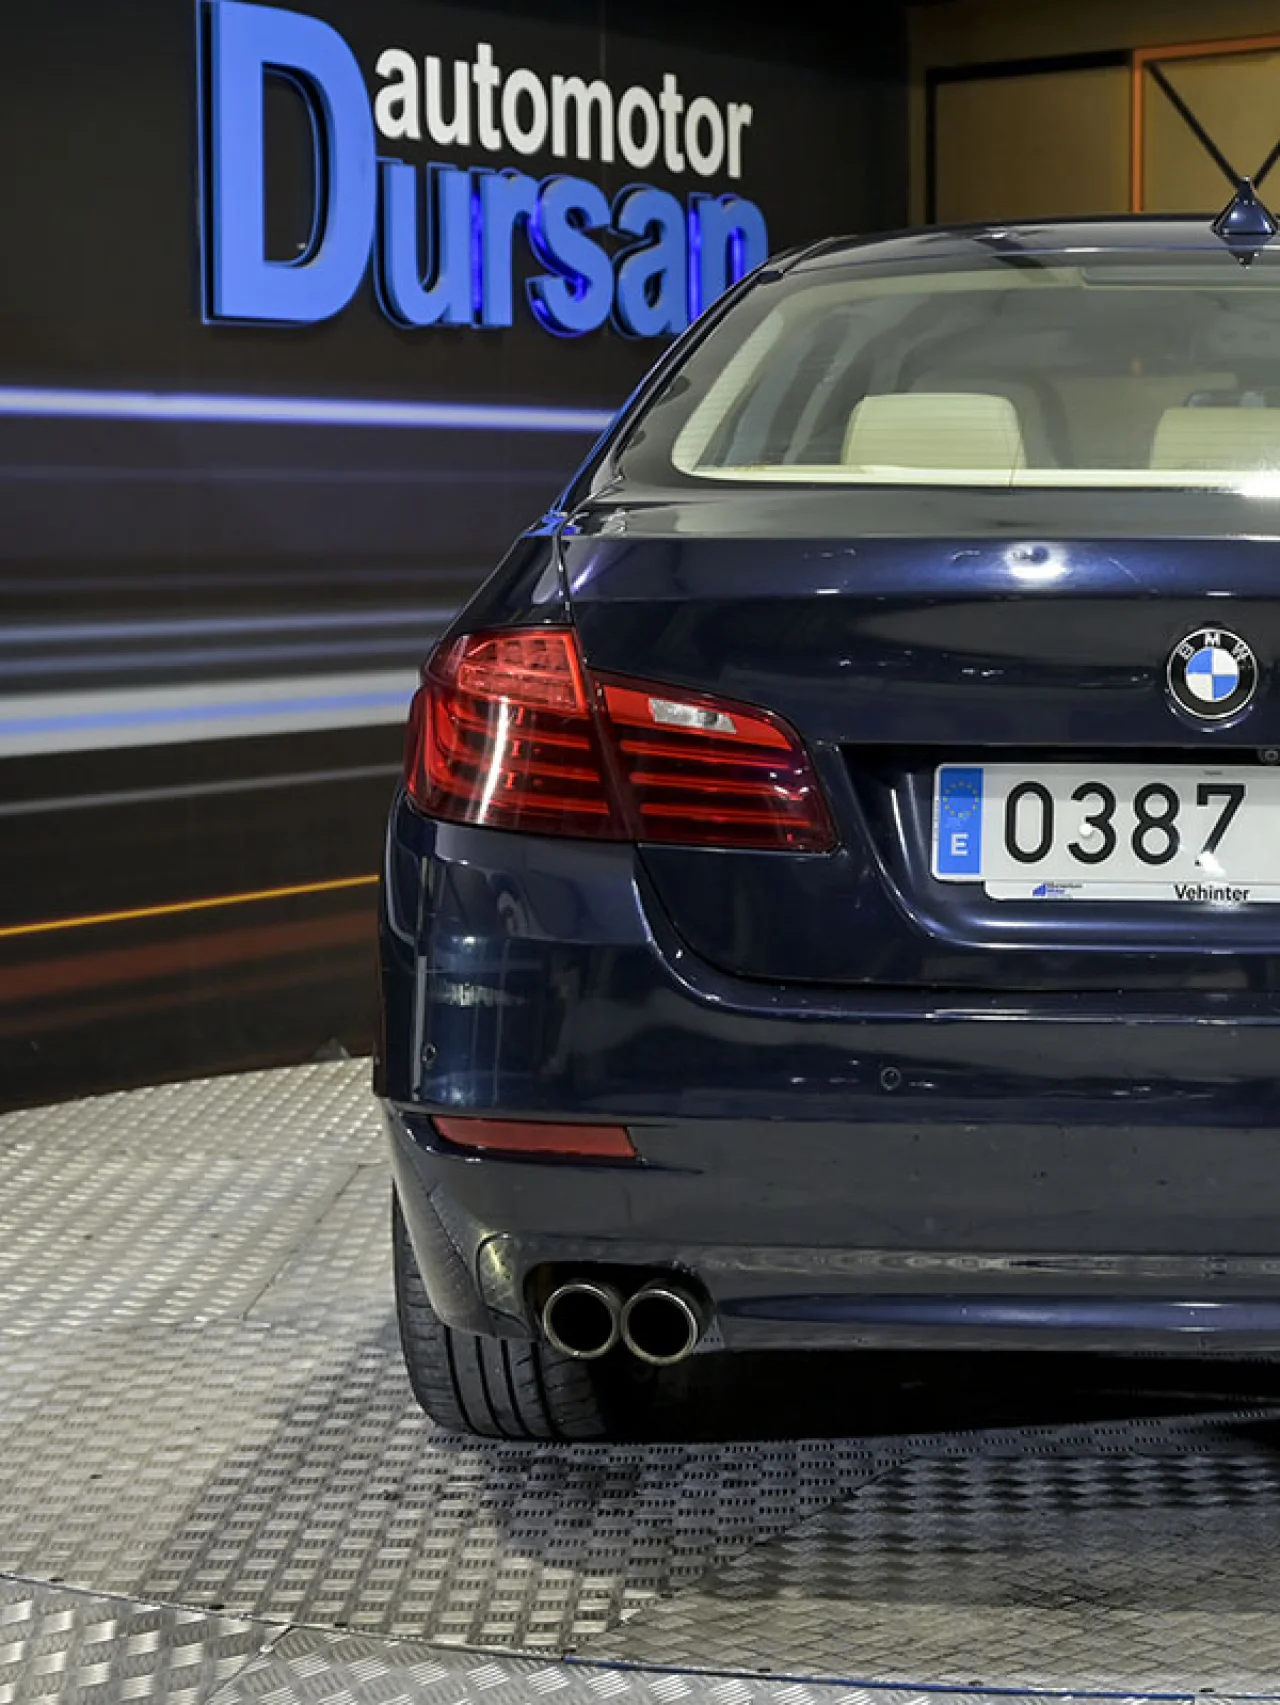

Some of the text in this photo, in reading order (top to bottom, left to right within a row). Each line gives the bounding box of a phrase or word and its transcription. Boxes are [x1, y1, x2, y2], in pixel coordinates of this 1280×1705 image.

[373, 42, 754, 178] automotor
[197, 0, 769, 338] Dursan
[950, 833, 969, 856] E
[1004, 781, 1246, 867] 0387
[1173, 883, 1250, 901] Vehinter
